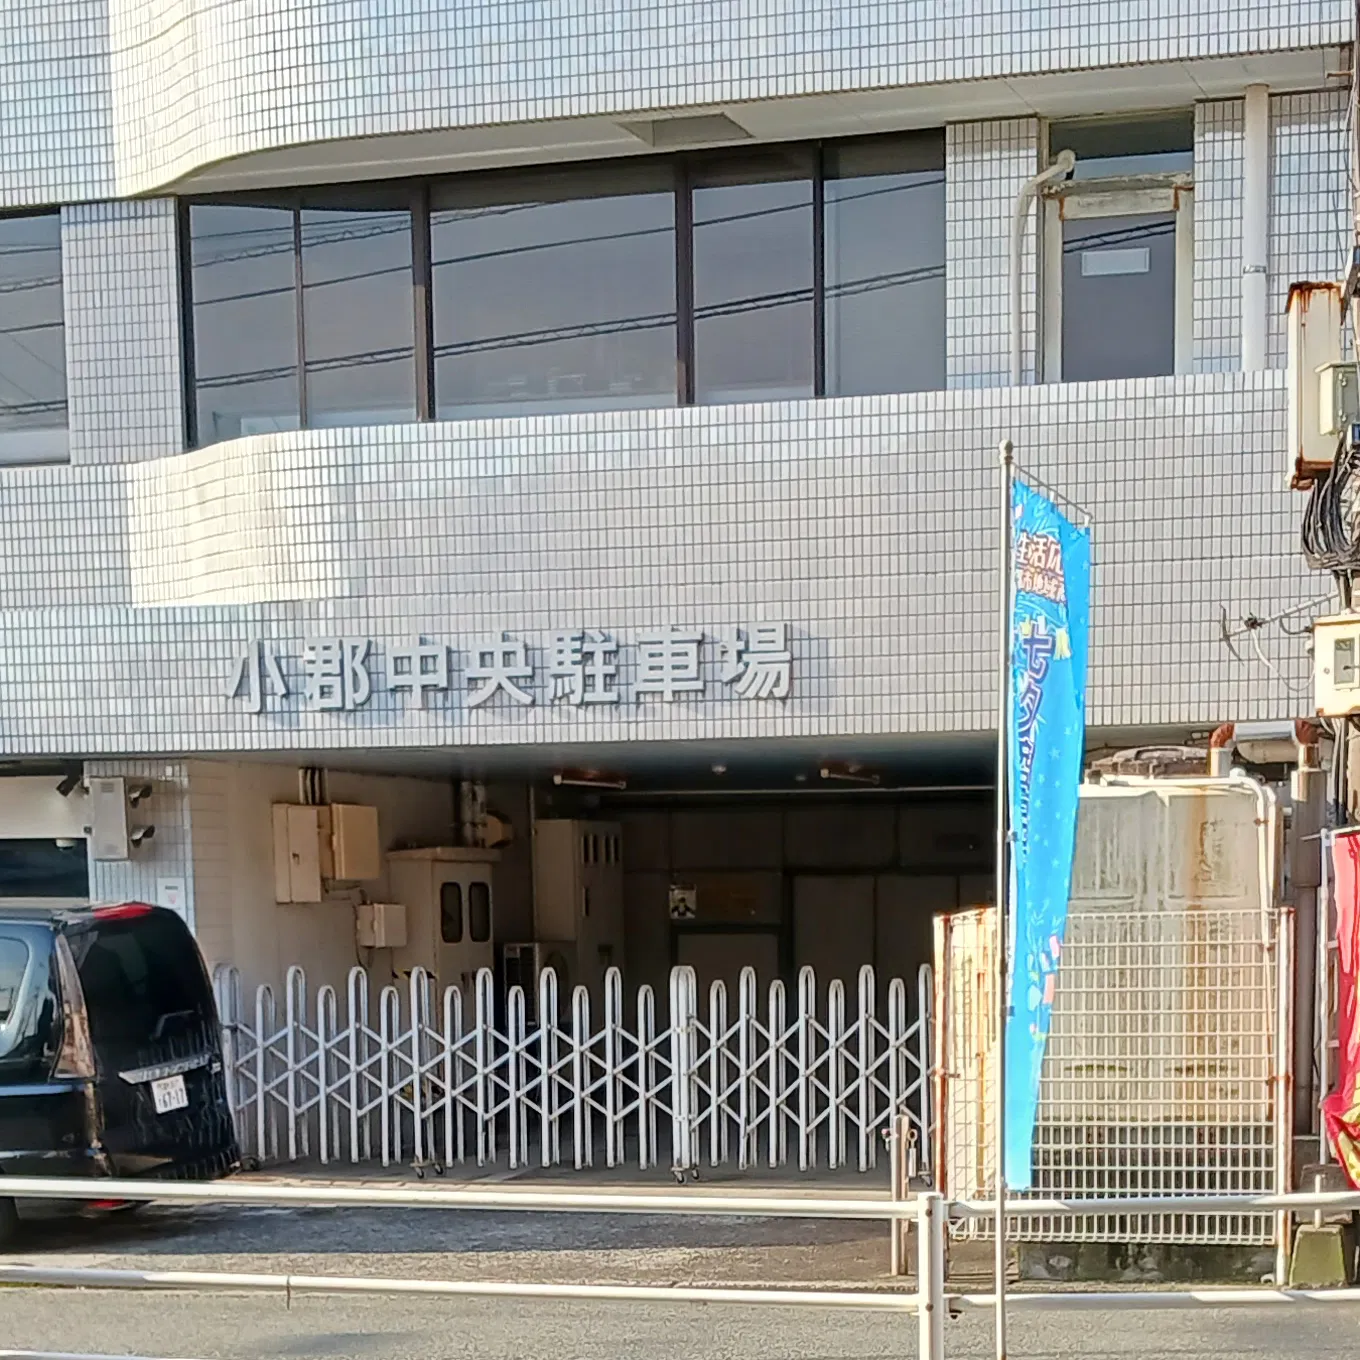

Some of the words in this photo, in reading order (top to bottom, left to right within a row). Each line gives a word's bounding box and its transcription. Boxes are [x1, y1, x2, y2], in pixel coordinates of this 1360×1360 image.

[224, 622, 794, 713] 小郡中央駐車場
